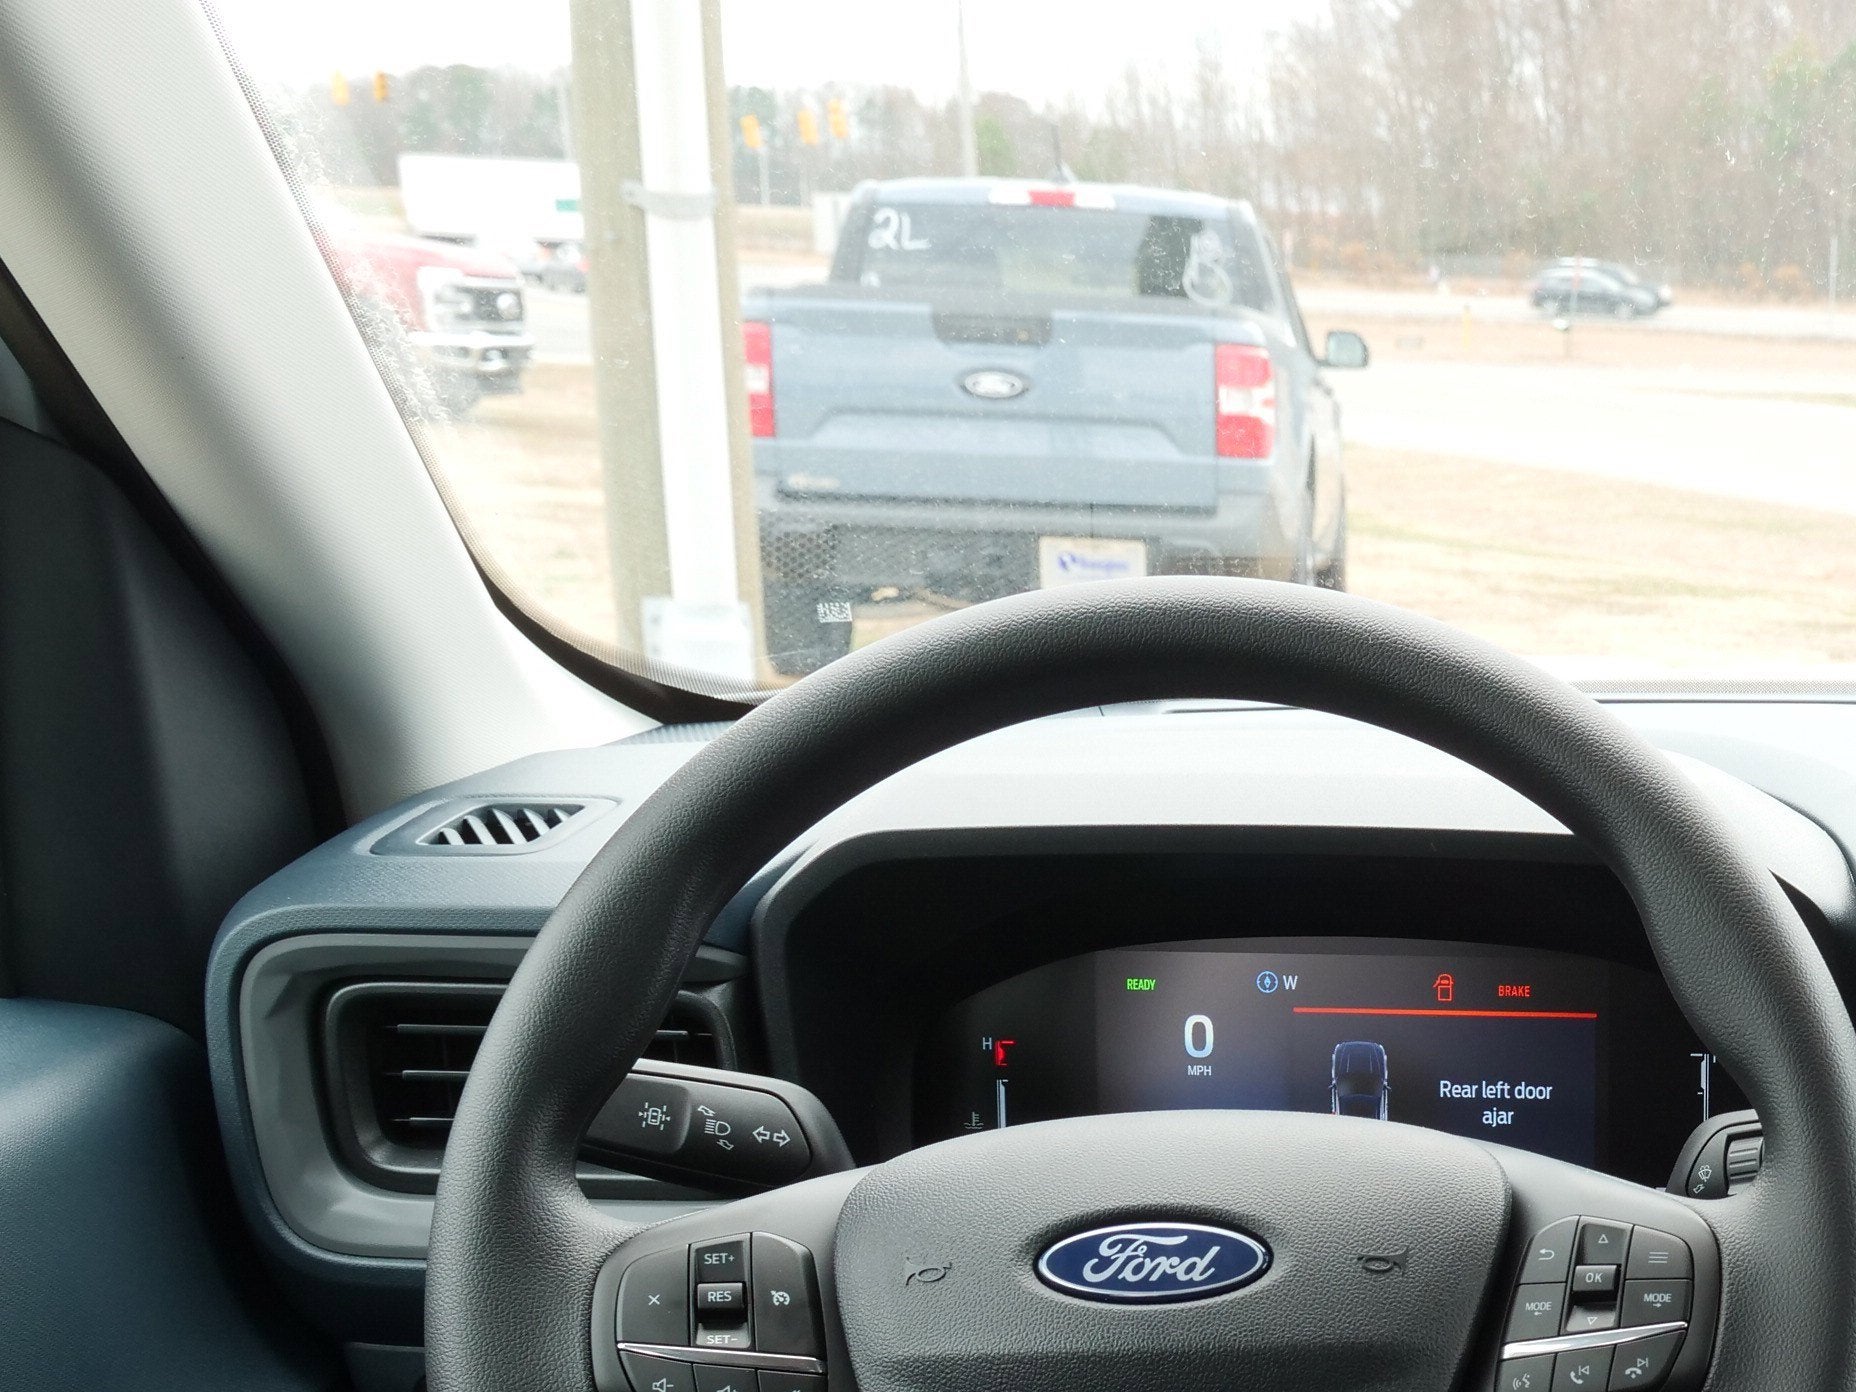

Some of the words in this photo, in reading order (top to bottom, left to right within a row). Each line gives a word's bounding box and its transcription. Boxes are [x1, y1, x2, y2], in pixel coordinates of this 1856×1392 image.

[1126, 978, 1156, 992] READY
[1282, 975, 1298, 990] W
[1498, 984, 1531, 998] BRAKE
[1184, 1014, 1214, 1058] 0
[982, 1037, 993, 1050] H
[1187, 1064, 1212, 1077] MPH
[1439, 1080, 1478, 1100] Rear
[1482, 1080, 1510, 1100] left
[1514, 1081, 1553, 1101] door
[1482, 1106, 1515, 1129] ajar
[1081, 1233, 1221, 1283] Ford
[1585, 1272, 1603, 1284] OK
[707, 1290, 732, 1303] RES
[1643, 1292, 1672, 1304] MODE
[1525, 1301, 1552, 1312] MODE
